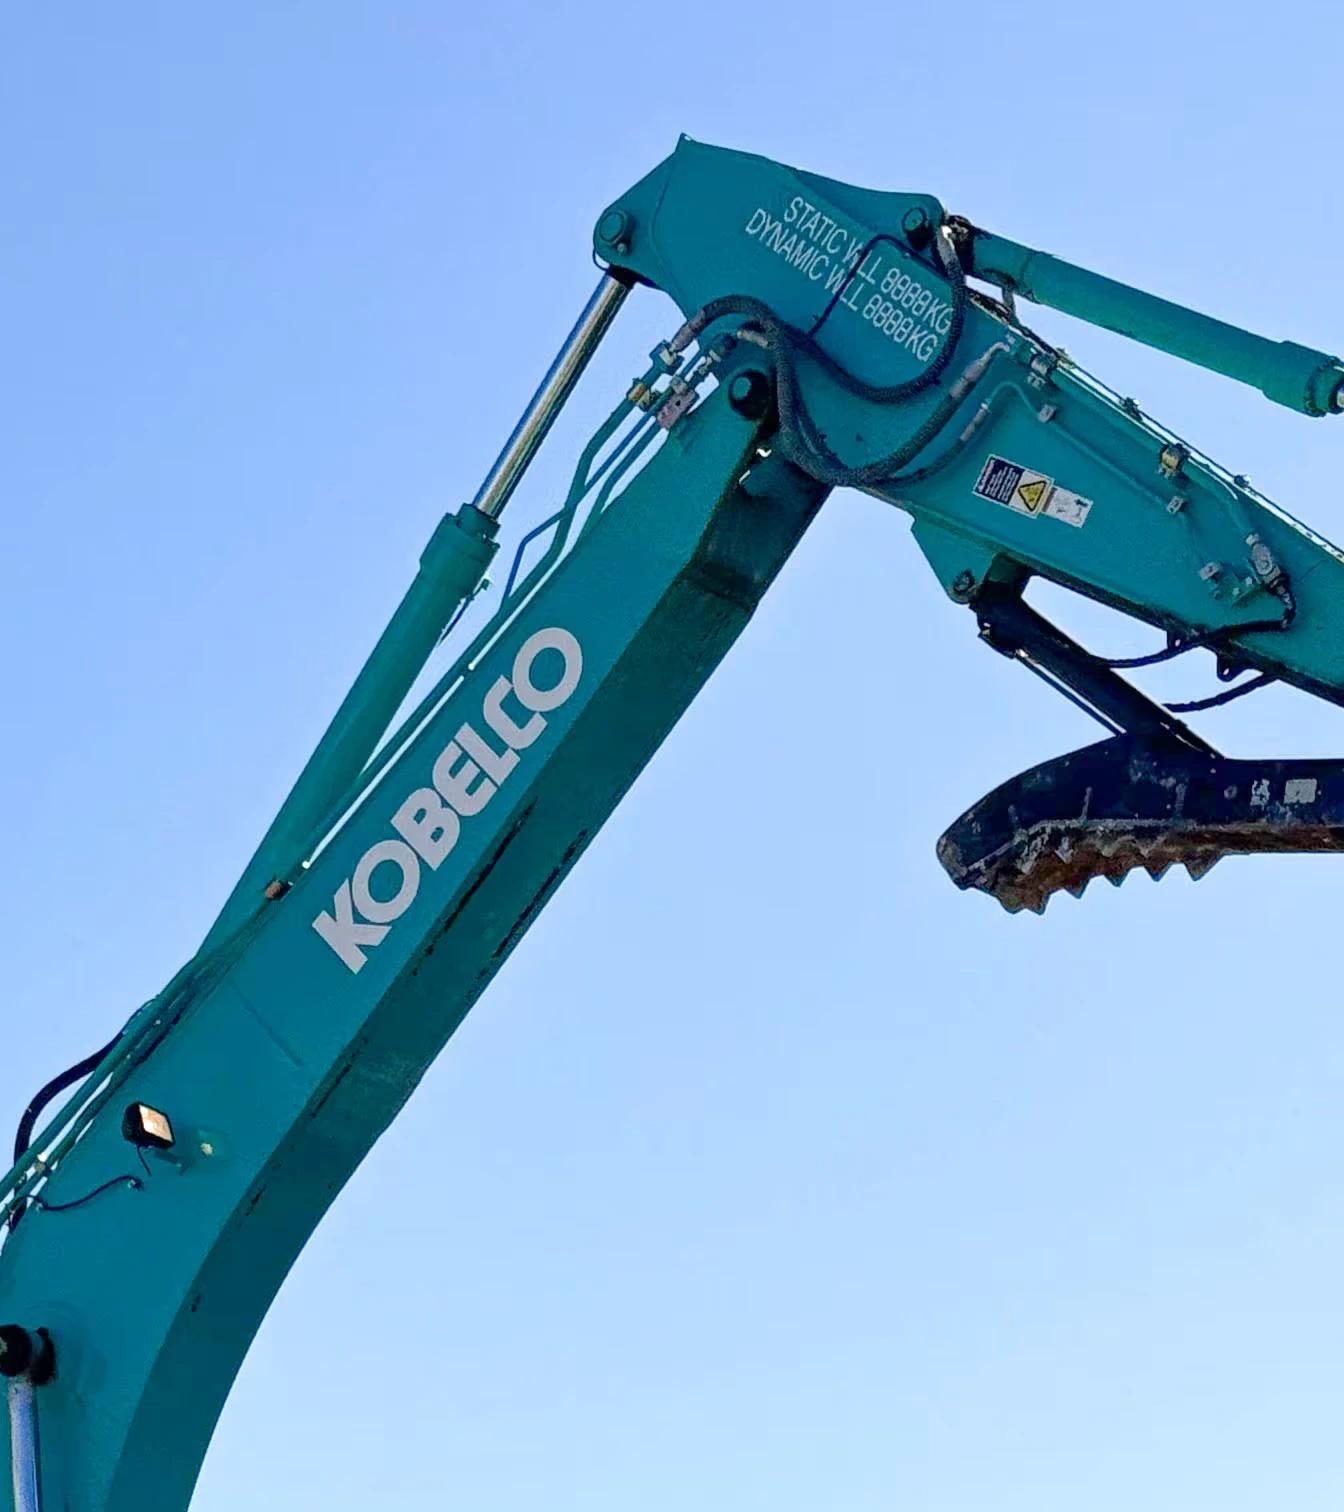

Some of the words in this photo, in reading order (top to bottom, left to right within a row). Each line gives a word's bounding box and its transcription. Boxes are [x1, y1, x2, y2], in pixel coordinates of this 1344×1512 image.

[745, 208, 830, 280] DYNAMIC
[824, 263, 864, 312] WLL
[862, 294, 938, 362] 8888KG
[784, 197, 848, 255] STATIC
[880, 267, 954, 335] 8888KG
[312, 627, 583, 975] KOBELCO
